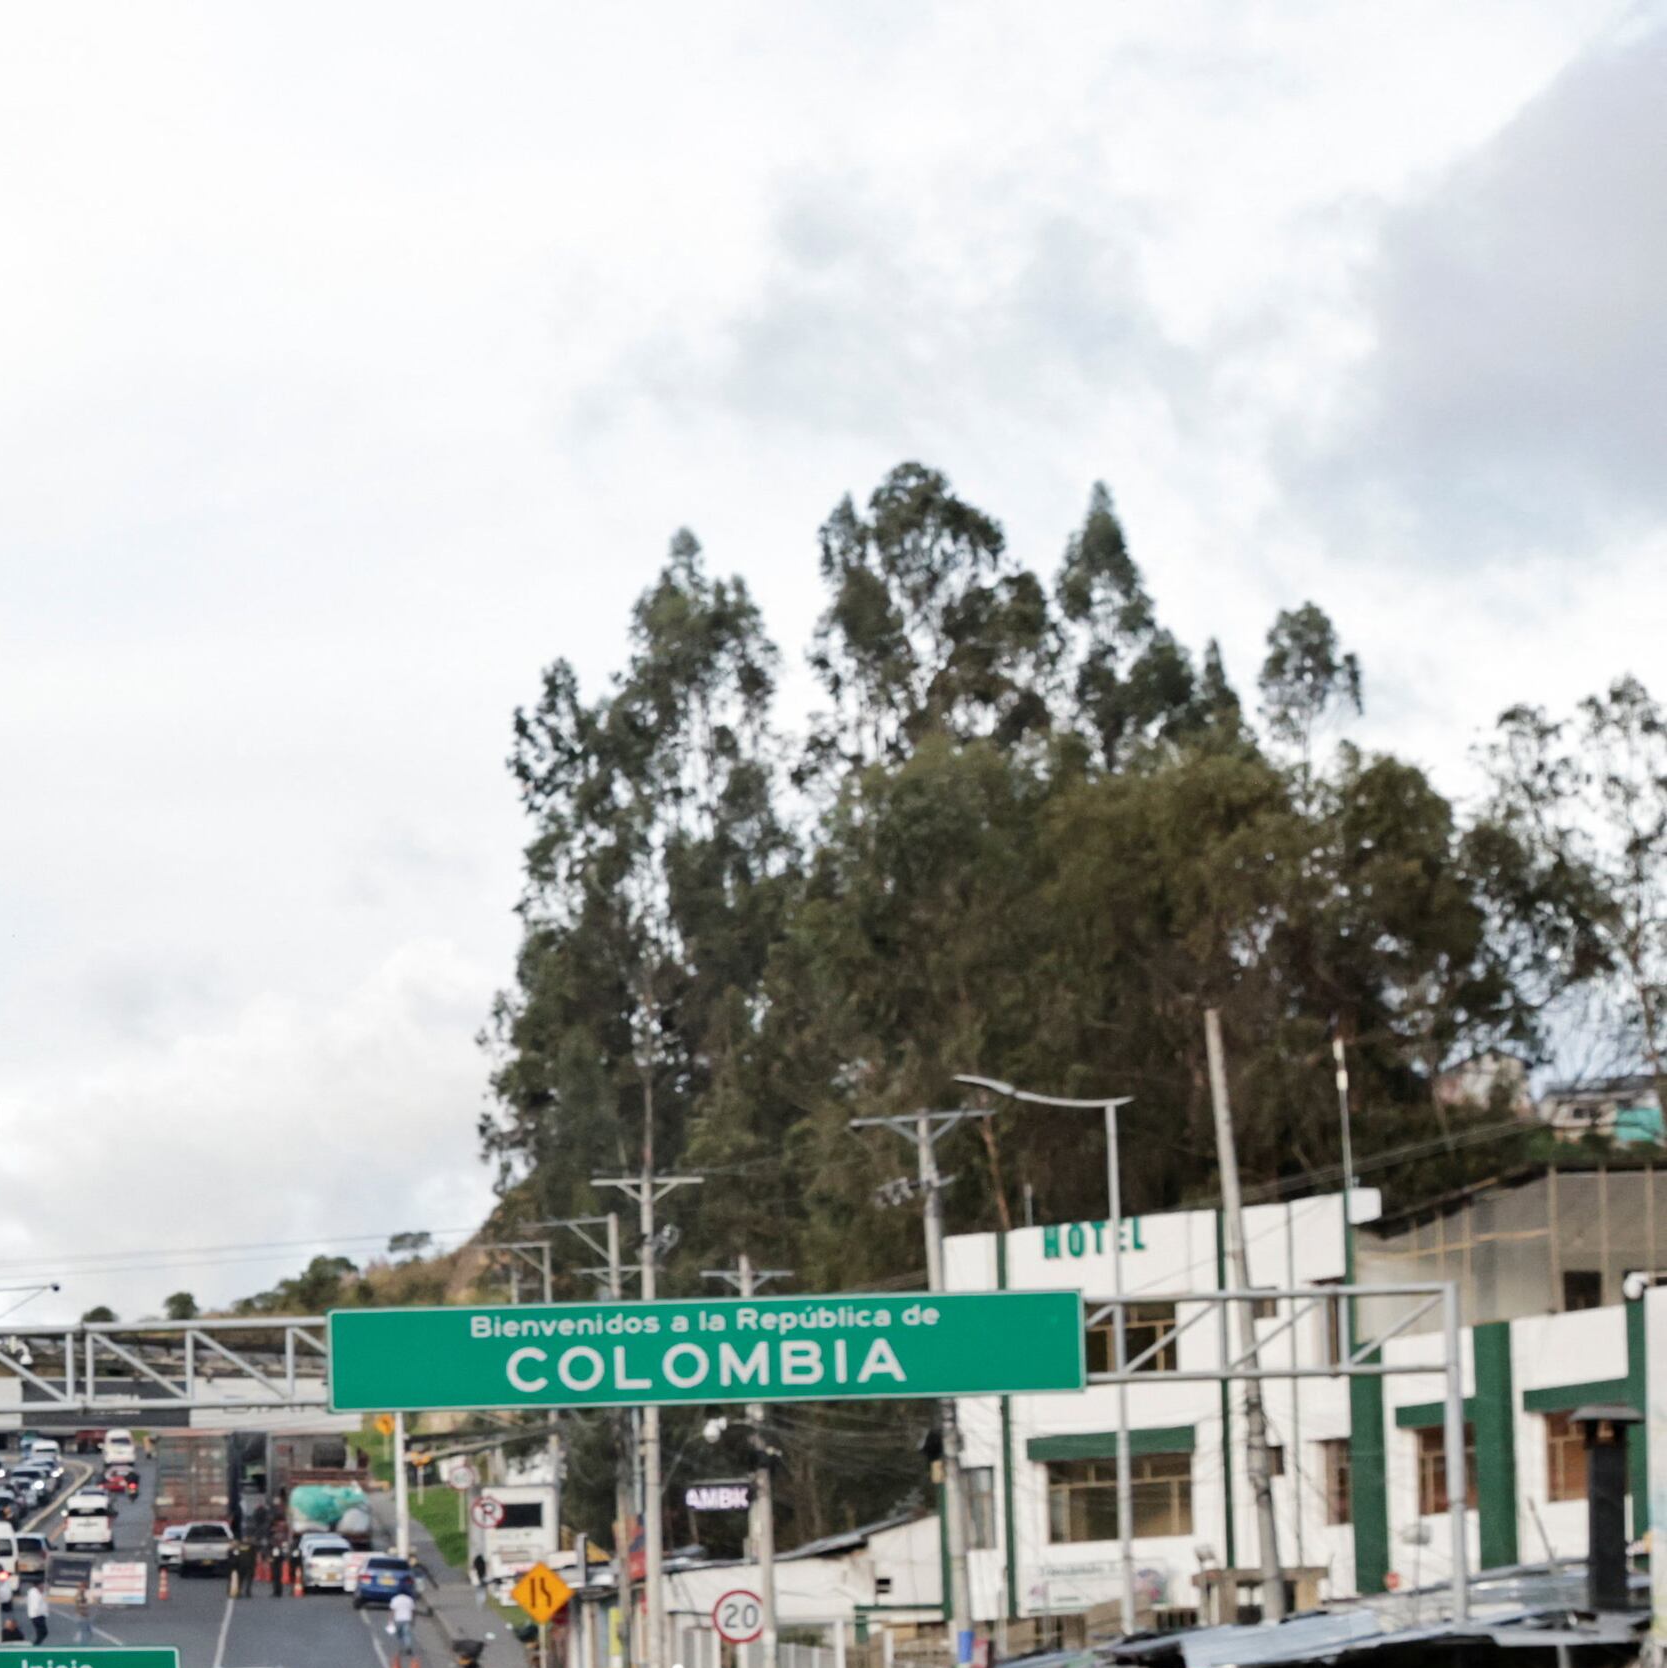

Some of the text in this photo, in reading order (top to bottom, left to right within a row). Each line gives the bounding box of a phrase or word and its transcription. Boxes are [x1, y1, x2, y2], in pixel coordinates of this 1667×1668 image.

[470, 1304, 941, 1338] Bienvenidos a la República de
[506, 1337, 908, 1393] COLOMBIA
[724, 1604, 759, 1629] 20
